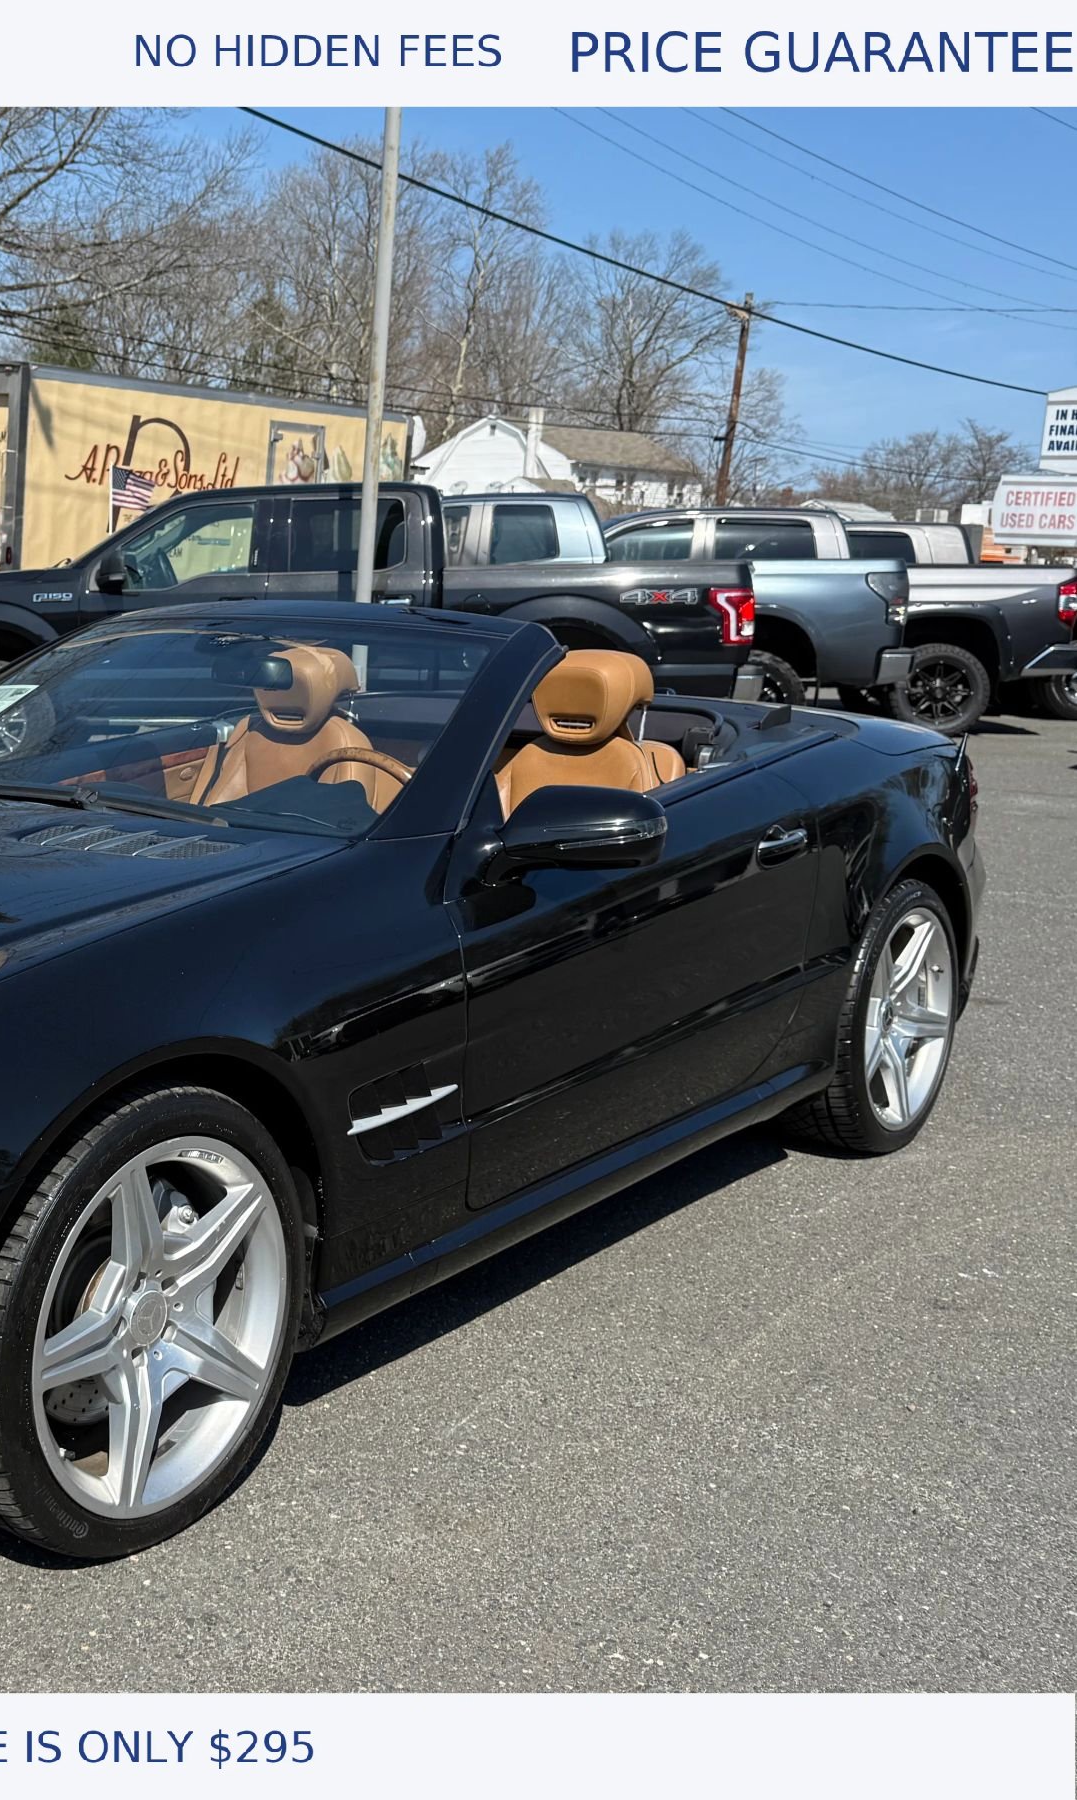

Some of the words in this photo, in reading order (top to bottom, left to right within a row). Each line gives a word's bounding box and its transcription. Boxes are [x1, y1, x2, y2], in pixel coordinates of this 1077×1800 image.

[1055, 409, 1068, 420] IN
[1049, 425, 1077, 436] FINA
[1005, 490, 1076, 506] CERTIFIED
[1000, 512, 1034, 528] USED
[1038, 513, 1075, 529] CARS
